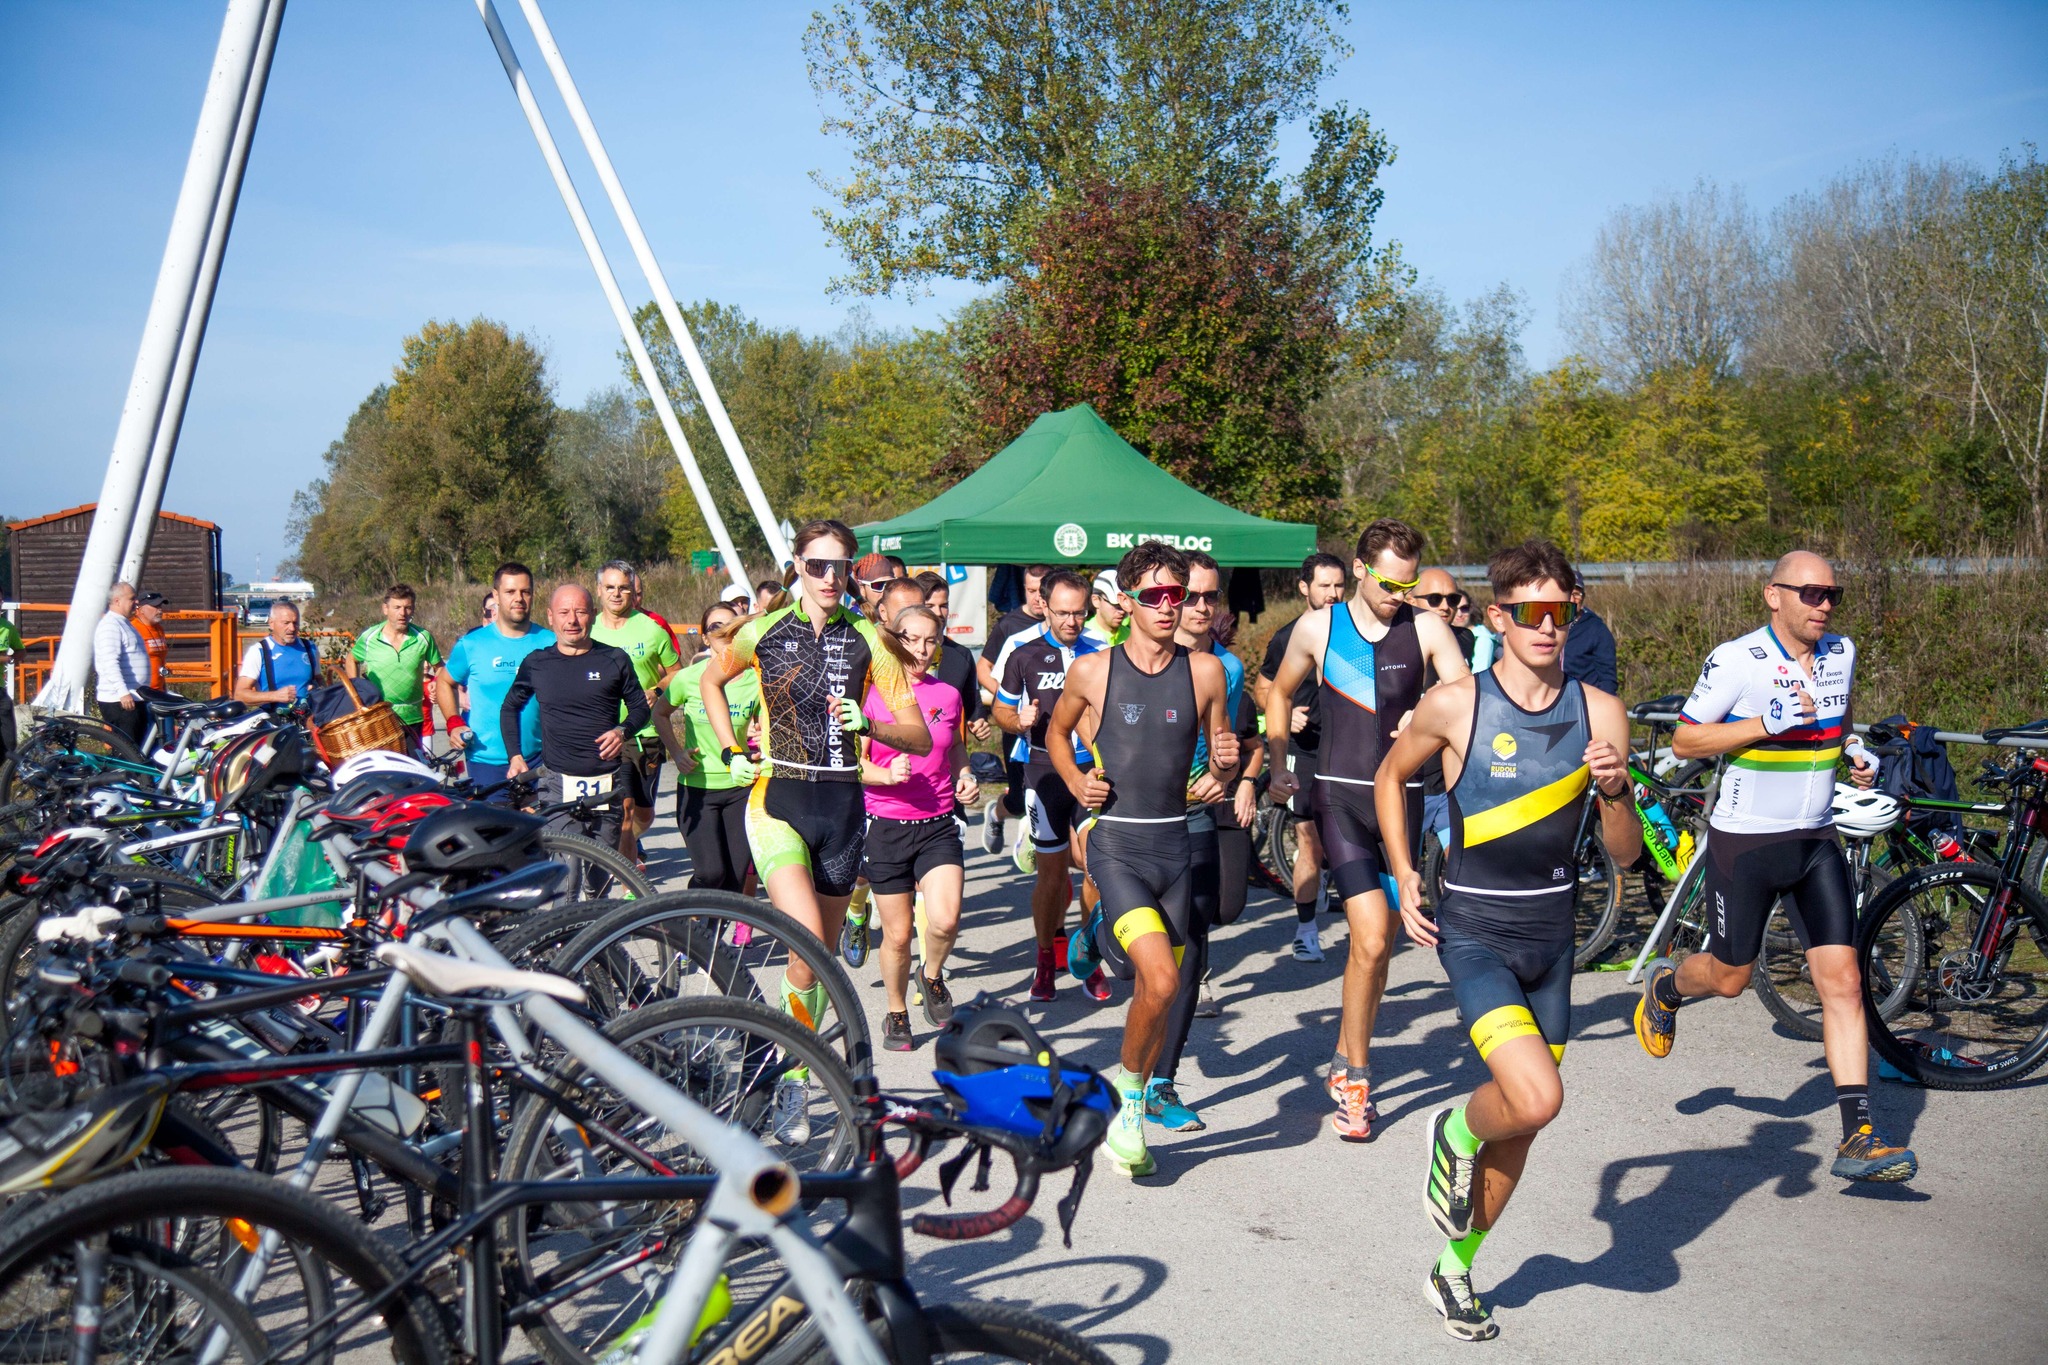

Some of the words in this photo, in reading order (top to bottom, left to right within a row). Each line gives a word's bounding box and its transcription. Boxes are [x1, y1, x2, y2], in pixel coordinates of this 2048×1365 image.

[1106, 533, 1135, 549] BK
[1037, 671, 1066, 690] Bl
[1816, 678, 1844, 688] latexco
[830, 747, 845, 768] BK
[576, 780, 600, 798] 31
[1909, 871, 1963, 891] MAXXIS
[1987, 1064, 1999, 1073] DT
[1999, 1055, 2019, 1069] SWISS
